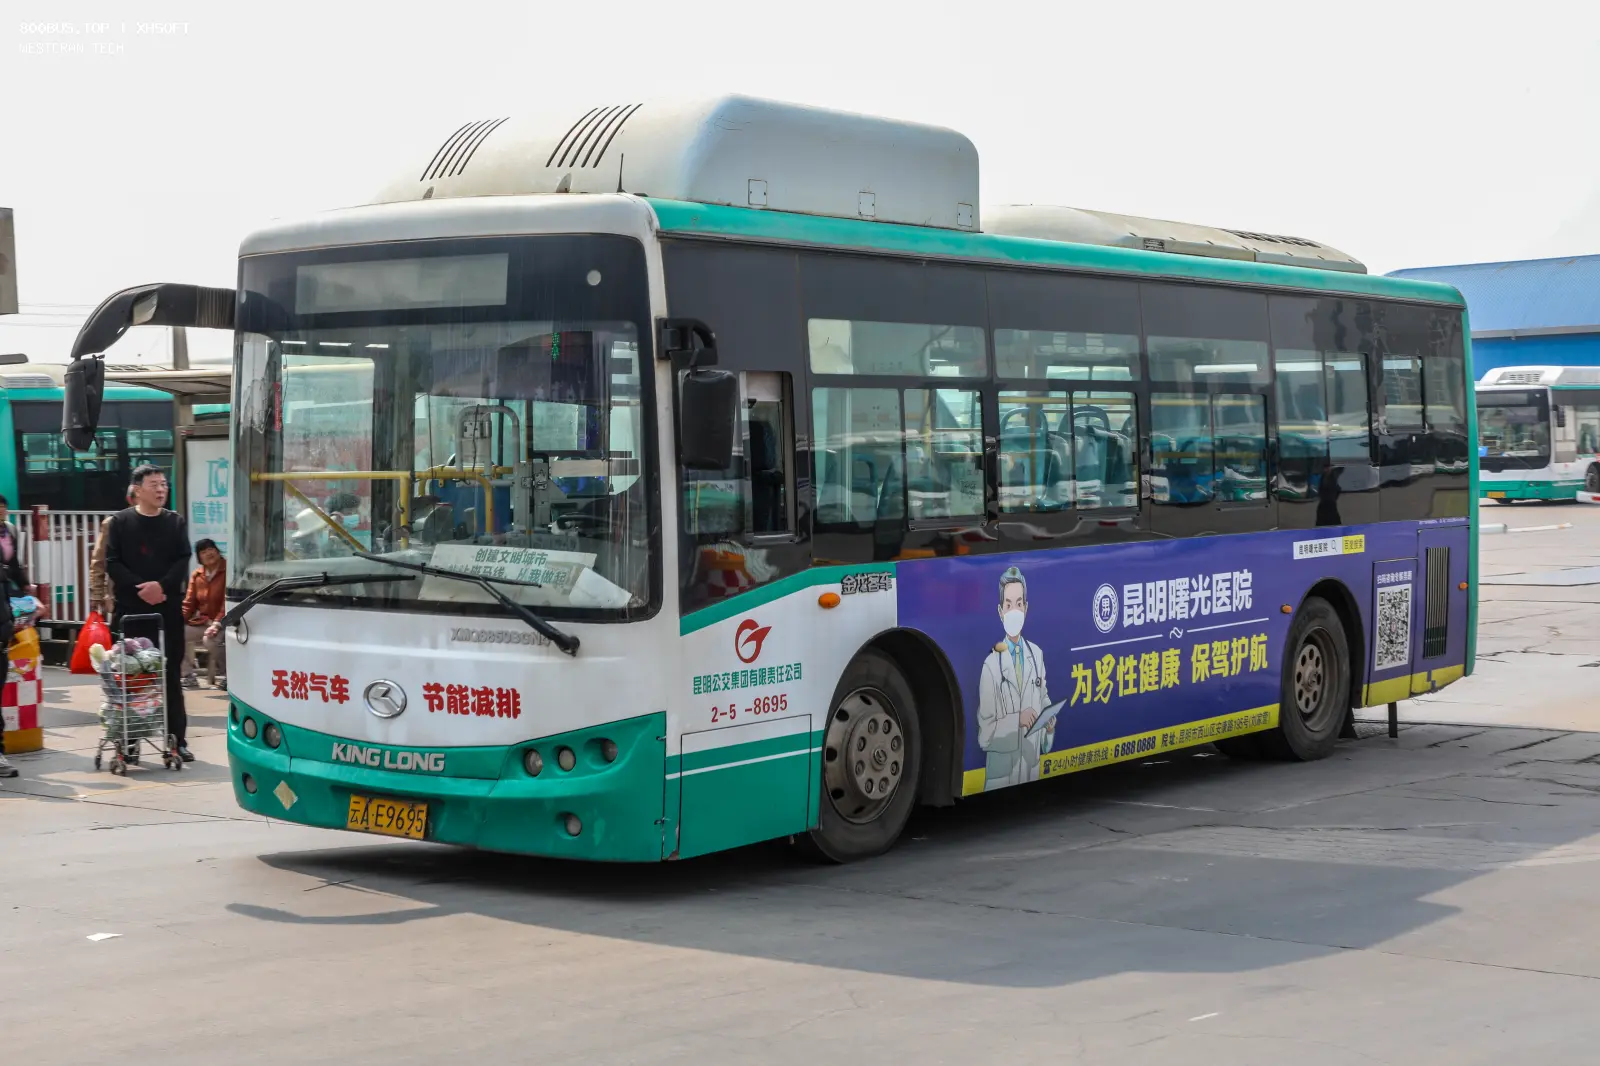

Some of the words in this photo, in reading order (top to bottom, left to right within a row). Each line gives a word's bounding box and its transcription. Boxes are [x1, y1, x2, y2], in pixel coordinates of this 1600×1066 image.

[475, 548, 548, 567] 创建文明城市
[841, 572, 893, 595] 金龙客车
[1122, 569, 1253, 628] 昆明曙光医院
[271, 669, 350, 704] 天然气车
[693, 663, 802, 695] 昆明公交集团有限责任公司
[1070, 648, 1181, 708] 为男性健康
[1191, 633, 1269, 684] 保驾护航
[422, 682, 521, 719] 节能减排
[332, 742, 381, 766] KING
[384, 751, 445, 772] LONG
